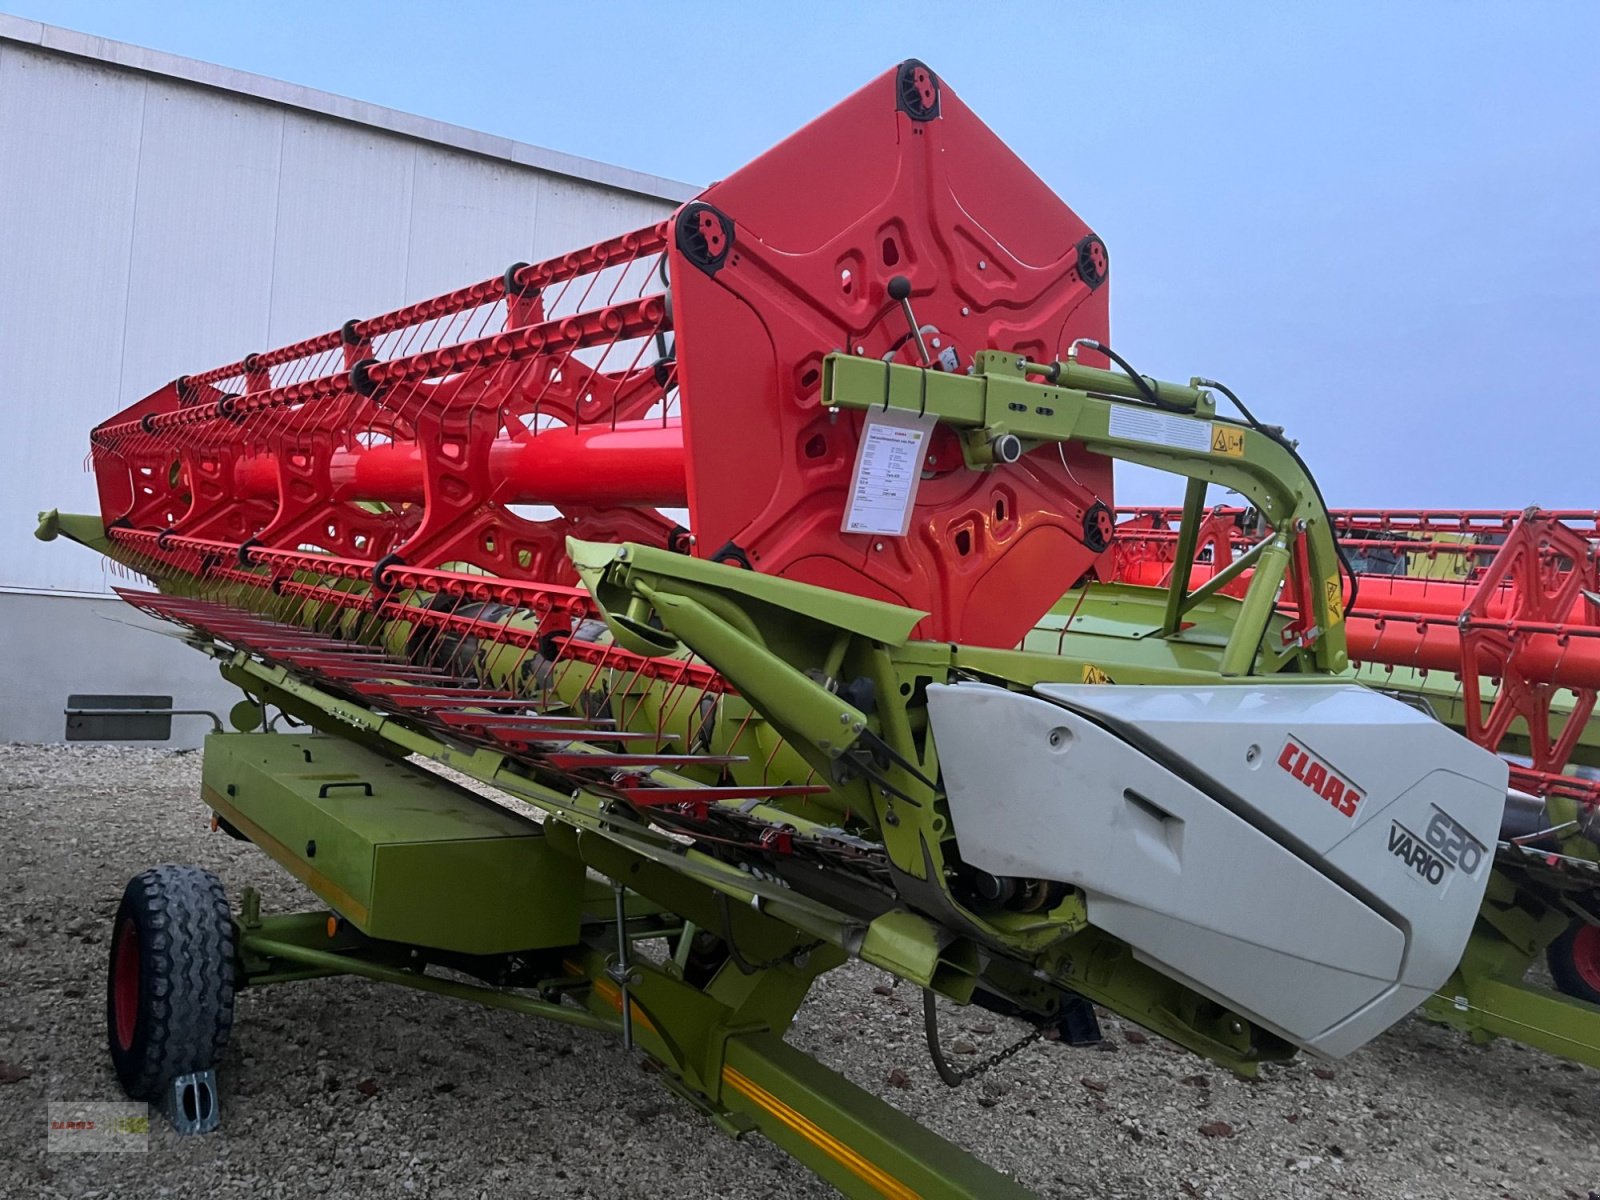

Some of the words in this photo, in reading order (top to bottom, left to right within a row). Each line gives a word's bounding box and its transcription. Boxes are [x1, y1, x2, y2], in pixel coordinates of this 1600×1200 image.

[1277, 742, 1360, 818] CLAAS
[1388, 825, 1445, 885] VARIO
[1426, 813, 1482, 875] 620
